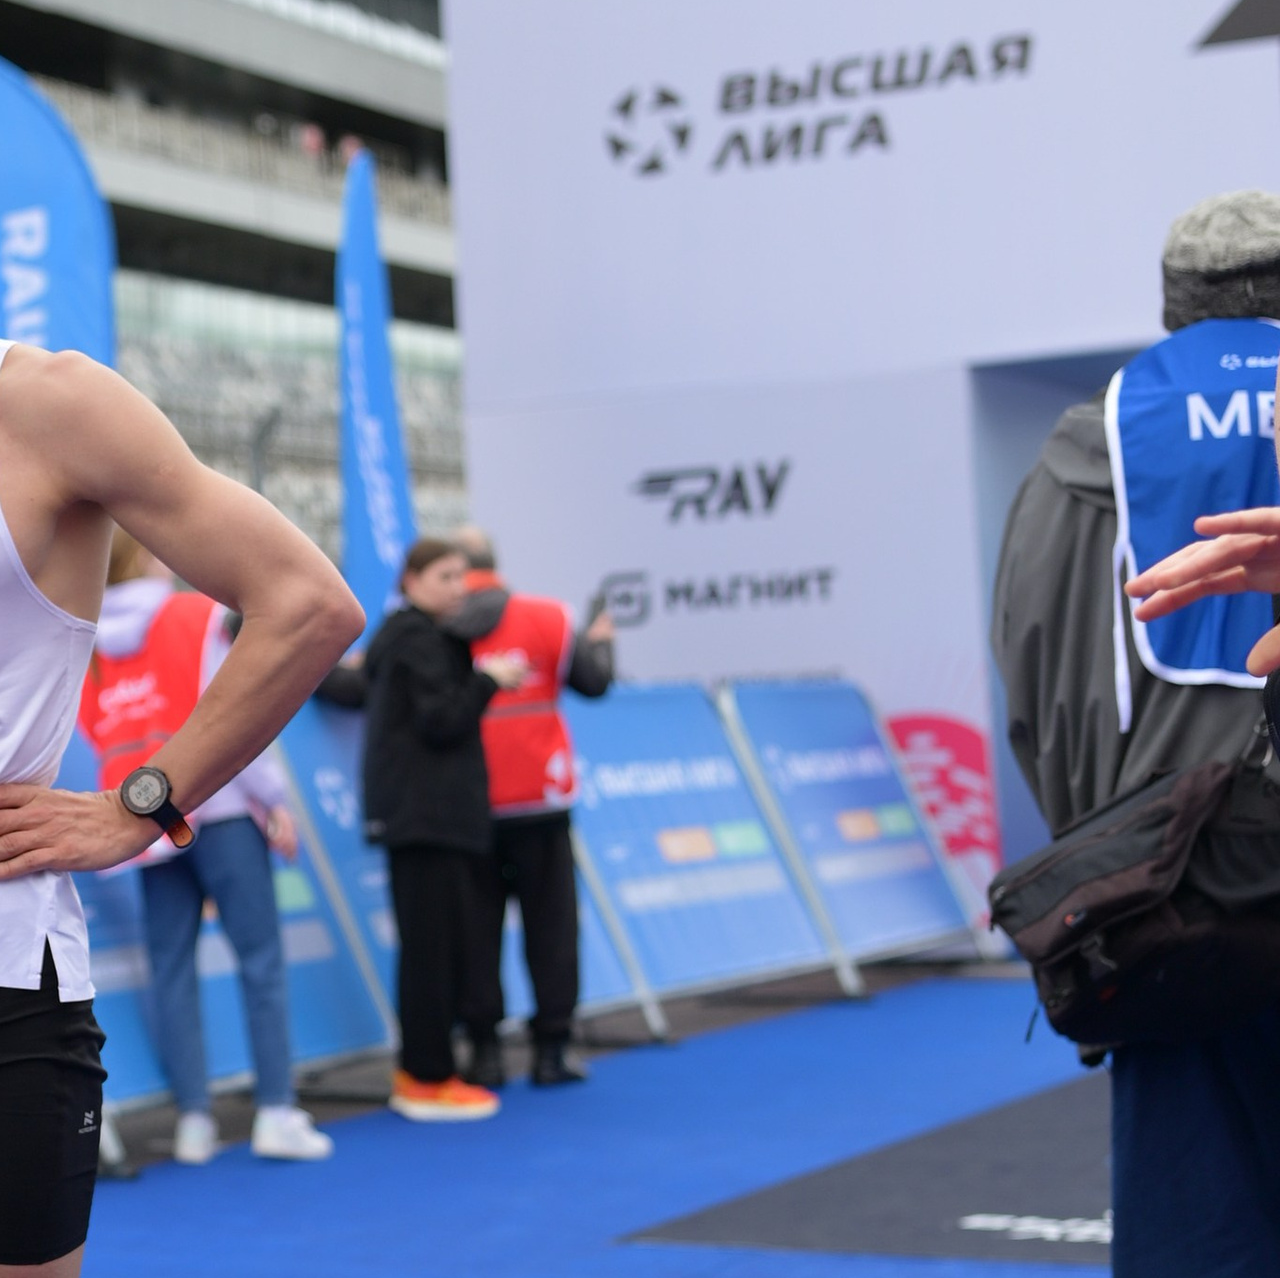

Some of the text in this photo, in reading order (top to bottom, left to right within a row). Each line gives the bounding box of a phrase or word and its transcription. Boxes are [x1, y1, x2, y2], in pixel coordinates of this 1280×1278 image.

[717, 33, 1035, 113] ВЫСШАЯ
[711, 109, 891, 174] ЛИГА
[635, 459, 790, 522] RAY
